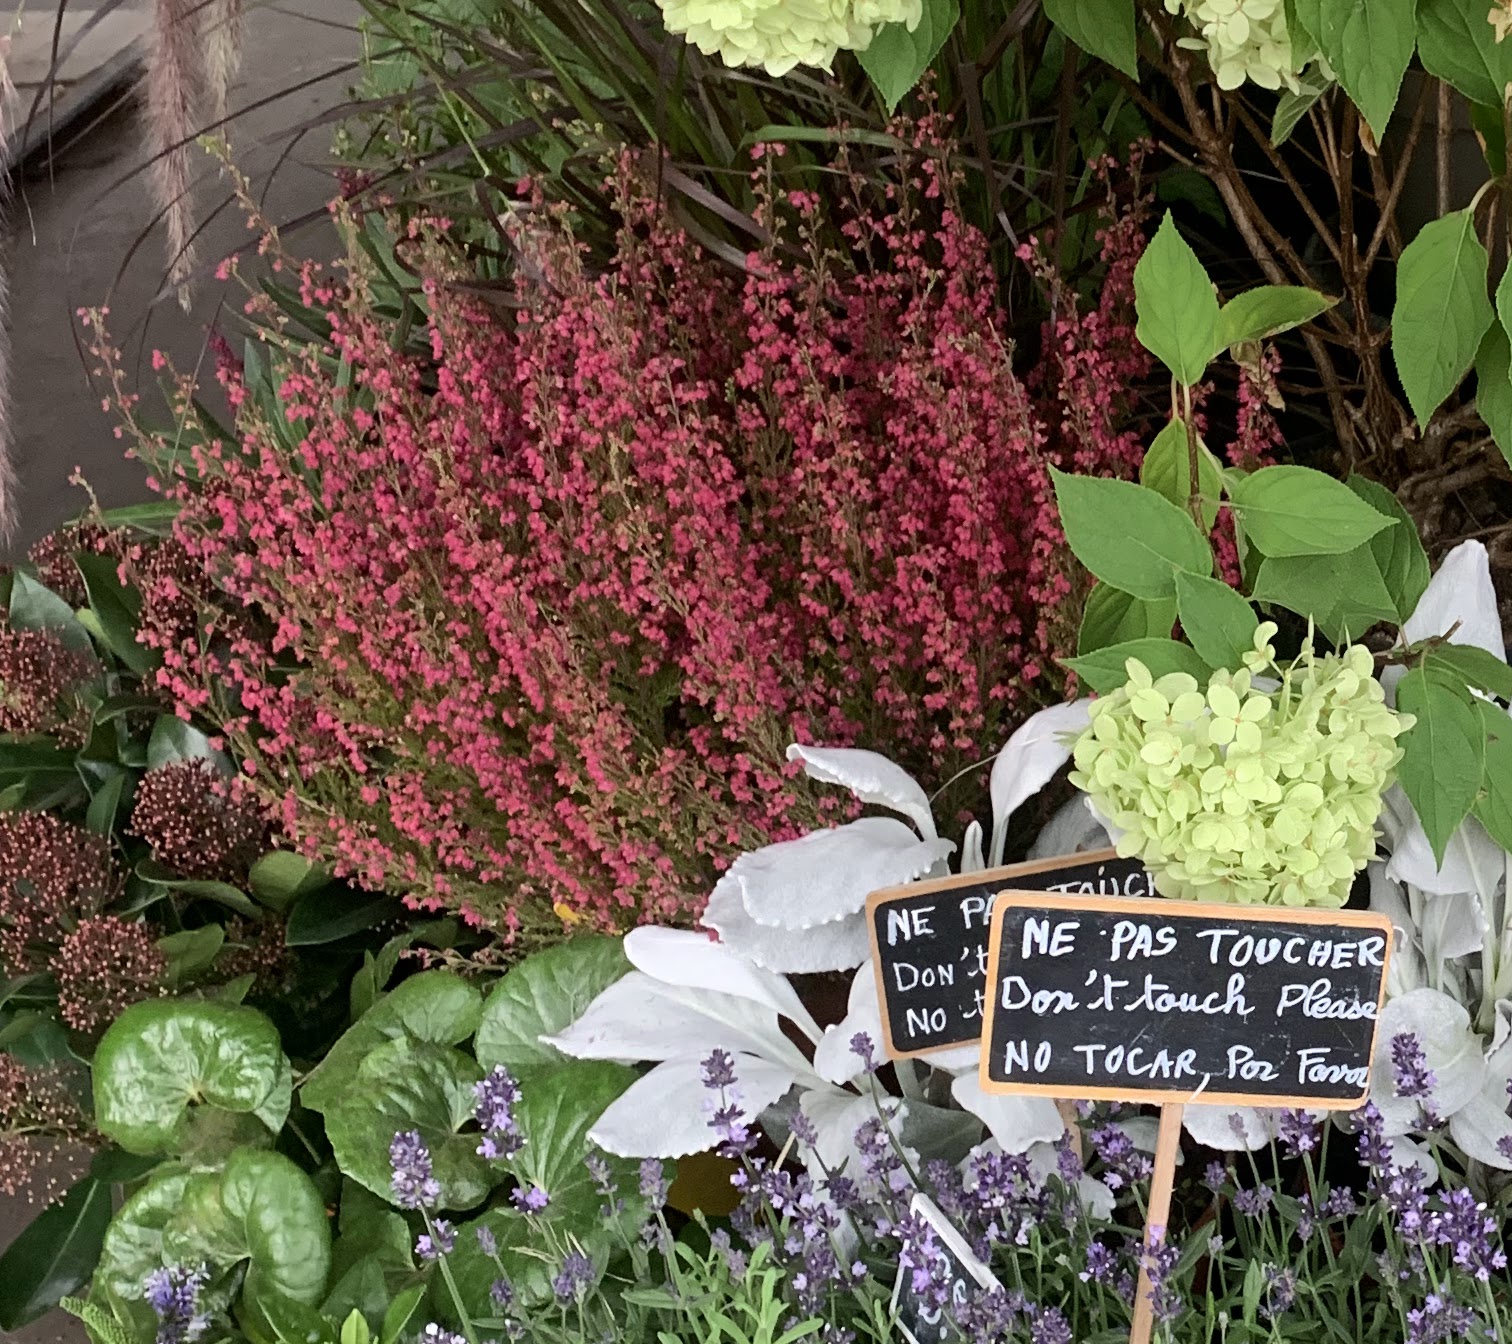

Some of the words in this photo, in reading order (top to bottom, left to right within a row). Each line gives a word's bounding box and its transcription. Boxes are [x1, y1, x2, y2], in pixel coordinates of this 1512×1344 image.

[887, 907, 935, 946] NE
[1021, 917, 1081, 960] NE
[1109, 920, 1178, 962] PAS
[1195, 929, 1385, 969] TOUCHER
[1001, 969, 1129, 1015] Don't
[1124, 972, 1256, 1015] touch
[1276, 978, 1380, 1020] Please
[906, 1007, 947, 1037] NO
[1004, 1039, 1052, 1075] NO
[1226, 1044, 1279, 1082] Por
